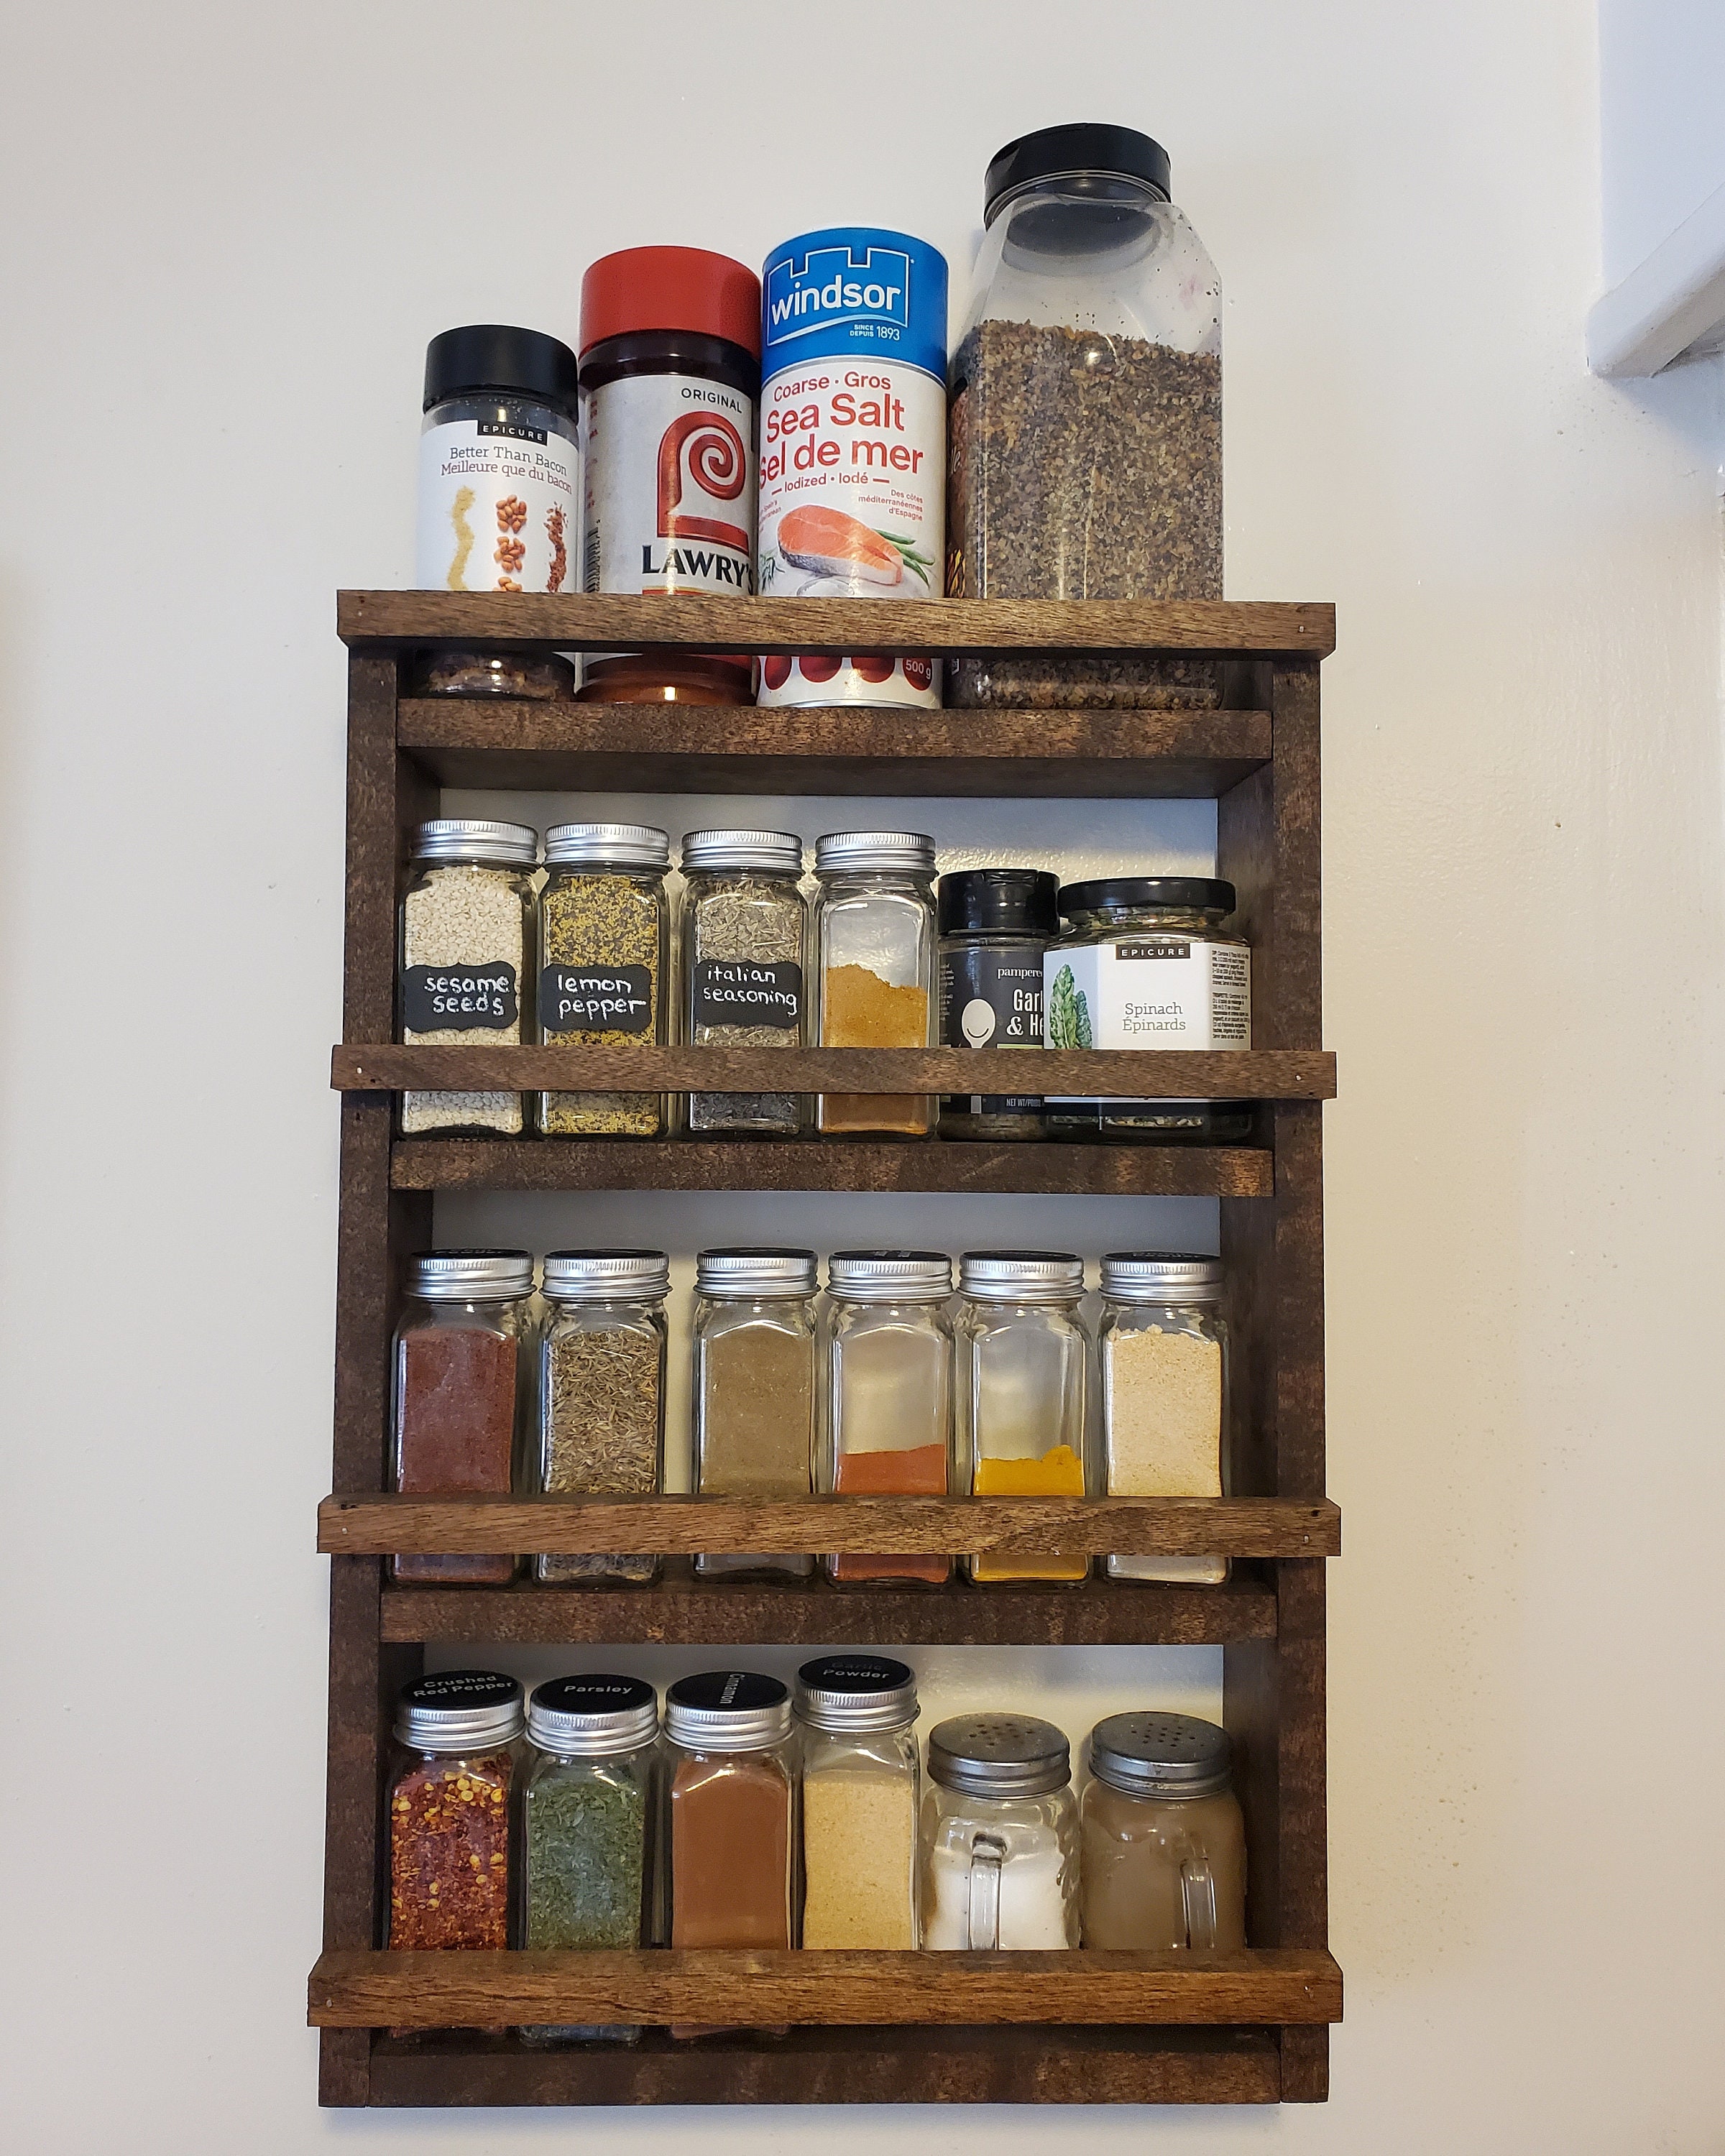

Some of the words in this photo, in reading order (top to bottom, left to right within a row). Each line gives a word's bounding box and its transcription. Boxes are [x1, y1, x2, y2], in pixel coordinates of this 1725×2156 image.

[771, 275, 901, 326] windsor
[876, 326, 900, 340] 1893
[774, 376, 829, 402] Coarse
[845, 372, 891, 390] Gros
[681, 387, 742, 414] ORIGINAL
[767, 400, 819, 443] Sea
[830, 393, 904, 431] Salt
[482, 425, 543, 442] EPICURE
[450, 446, 488, 459] Better
[494, 446, 530, 464] Than
[535, 453, 568, 476] Bacon
[794, 433, 841, 470] de
[852, 441, 924, 474] mer
[441, 461, 498, 476] Meilleure
[502, 466, 525, 480] que
[528, 467, 546, 483] du
[547, 472, 572, 494] bacon
[785, 473, 827, 492] Iodized
[858, 495, 923, 512] méditerranéennes
[891, 489, 904, 498] Des
[906, 492, 923, 503] côtes
[888, 507, 923, 521] d'Espagne
[642, 545, 753, 595] LAWRY'S
[905, 660, 924, 674] 500
[925, 667, 932, 679] g
[1121, 947, 1185, 957] EPICURE
[707, 966, 776, 983] italian
[998, 968, 1042, 980] pampere
[424, 975, 510, 993] sesame
[558, 974, 632, 993] lemon
[433, 992, 505, 1016] seeds
[559, 999, 647, 1021] pepper
[703, 987, 798, 1017] seasoning
[1125, 1002, 1183, 1015] Spinach
[1006, 1016, 1024, 1036] &
[1122, 1015, 1186, 1033] Épinards
[1006, 1098, 1016, 1107] NET
[423, 1675, 497, 1688] Crushed
[823, 1669, 889, 1678] Powder
[413, 1687, 449, 1697] Red
[452, 1681, 512, 1692] Pepper
[564, 1685, 632, 1695] Parsley
[719, 1674, 745, 1704] Cinnamon
